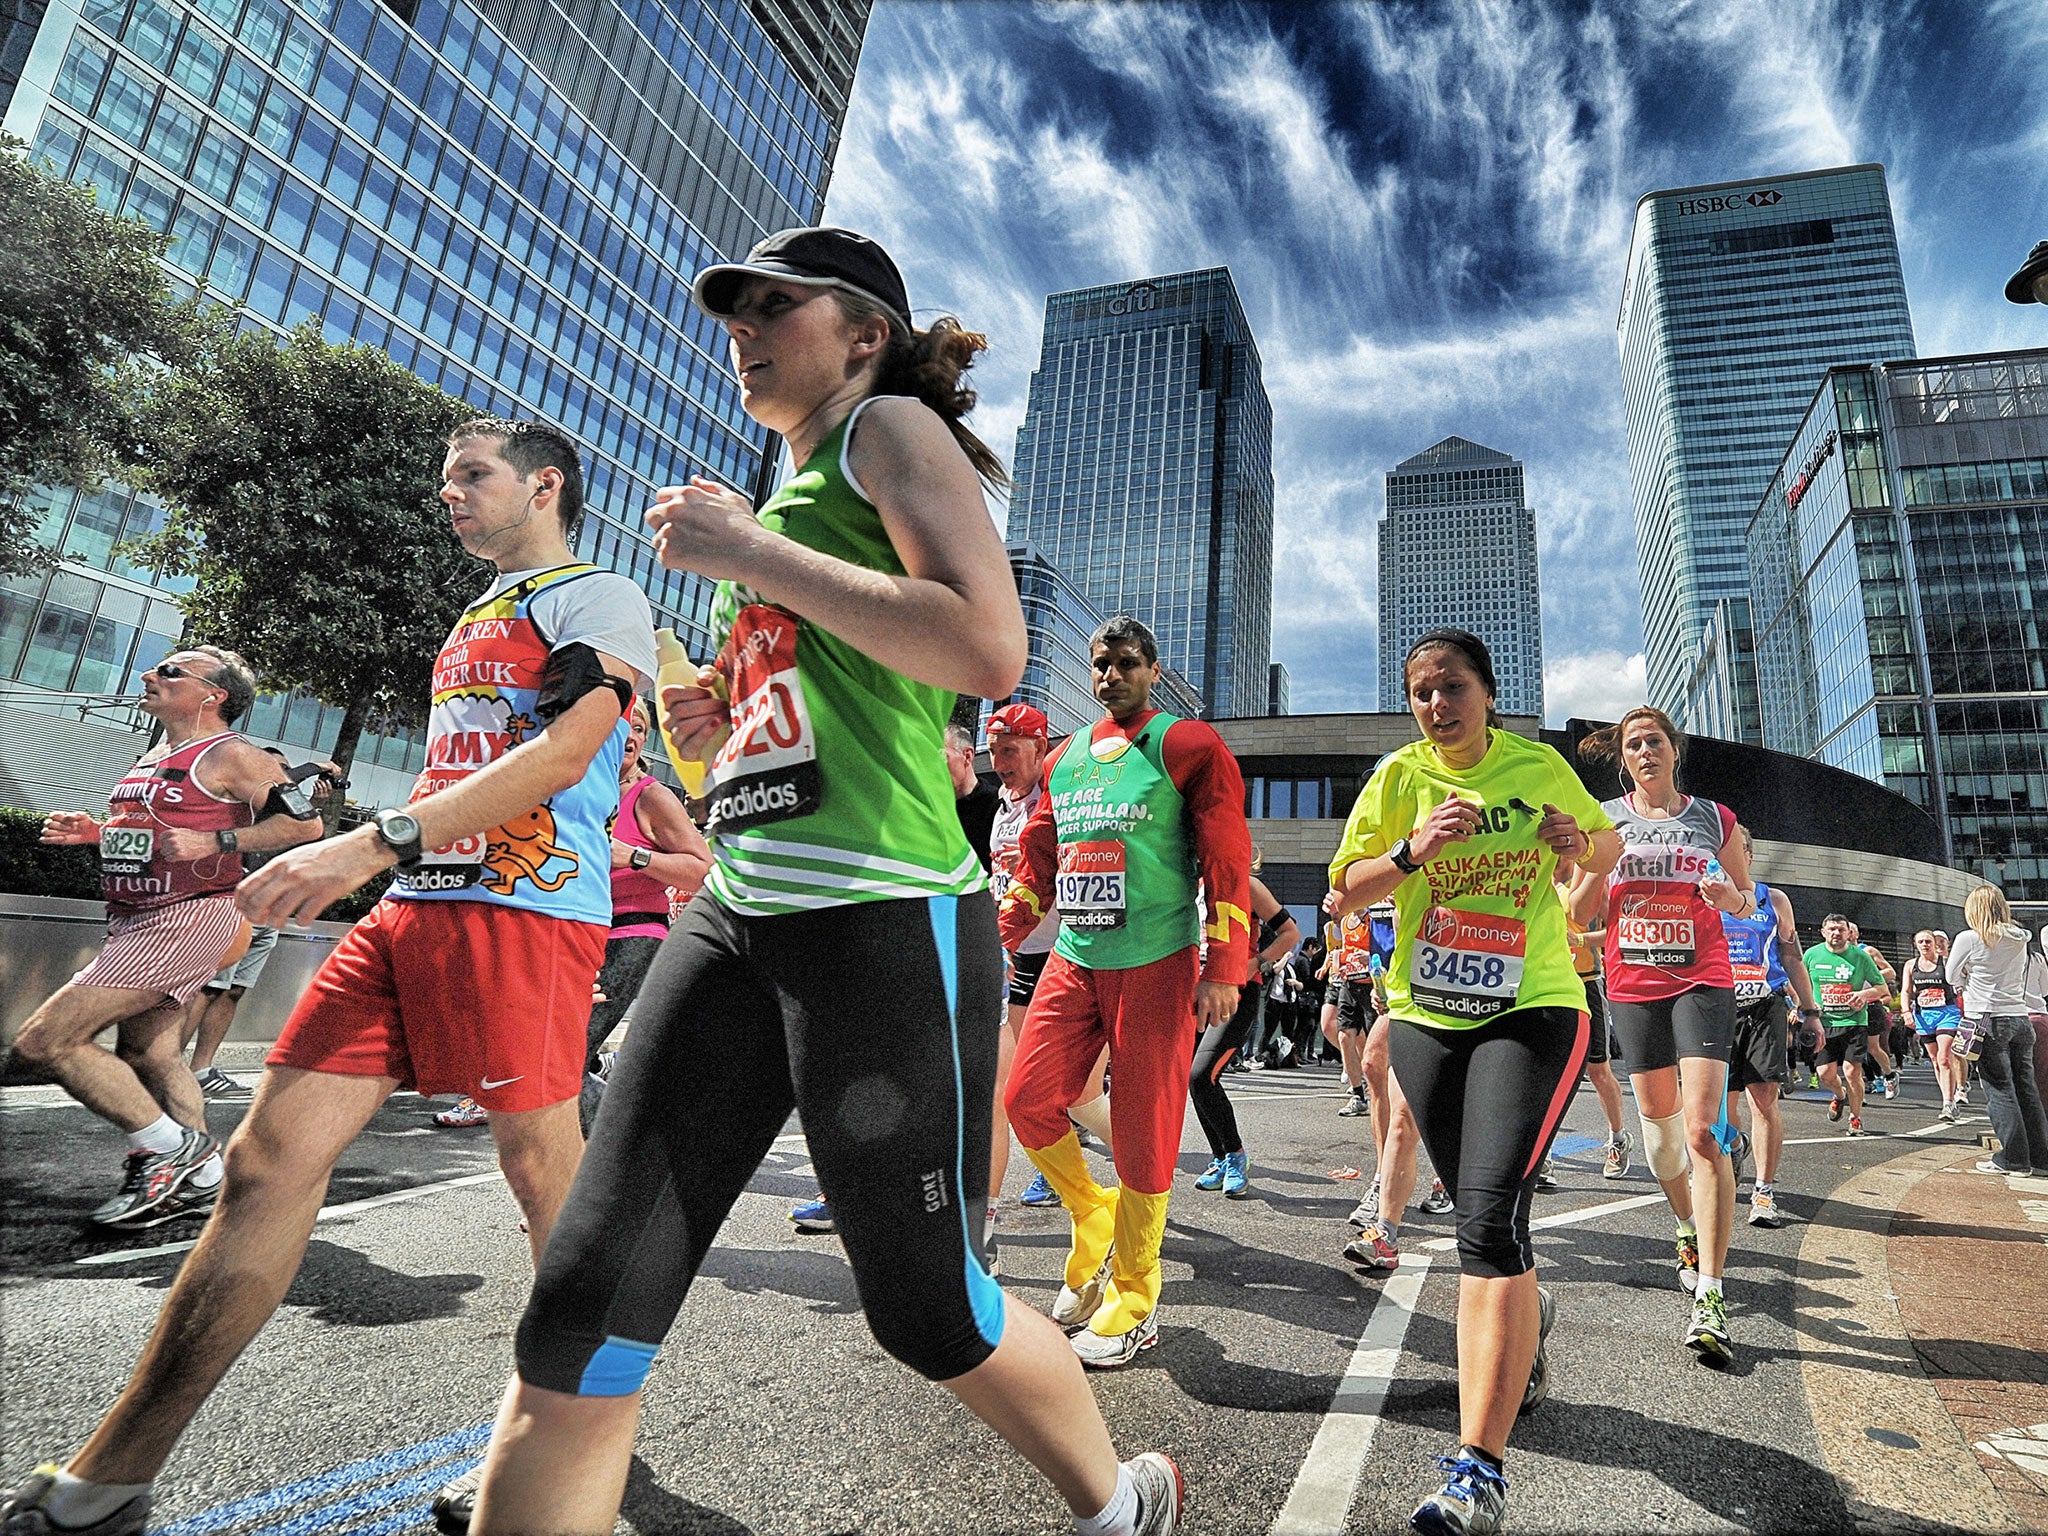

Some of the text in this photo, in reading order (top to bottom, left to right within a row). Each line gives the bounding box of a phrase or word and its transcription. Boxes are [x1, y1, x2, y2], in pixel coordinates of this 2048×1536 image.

[1677, 194, 1743, 217] HSBC
[1108, 284, 1156, 316] citi
[442, 620, 516, 650] ILDREN
[442, 643, 469, 669] with
[473, 661, 518, 685] UK
[426, 731, 514, 767] MMY
[1070, 762, 1128, 786] RAJ
[110, 781, 183, 804] mmy's
[720, 782, 798, 821] adidas
[1073, 787, 1105, 804] ARE
[1082, 820, 1137, 833] SUPPORT
[1080, 851, 1121, 864] money
[1422, 848, 1541, 877] LEUKAEMIA
[1057, 875, 1121, 903] 19725
[1431, 883, 1511, 904] RSERCH
[1077, 912, 1116, 926] adidas
[1650, 902, 1688, 915] money
[1750, 914, 1769, 922] KEV
[1426, 906, 1519, 946] Virgin money
[1620, 921, 1691, 944] 49306
[1420, 946, 1505, 989] 3458
[1736, 968, 1763, 977] money
[1735, 982, 1764, 996] 237
[1445, 998, 1501, 1016] adidas
[921, 1171, 940, 1213] GORE
